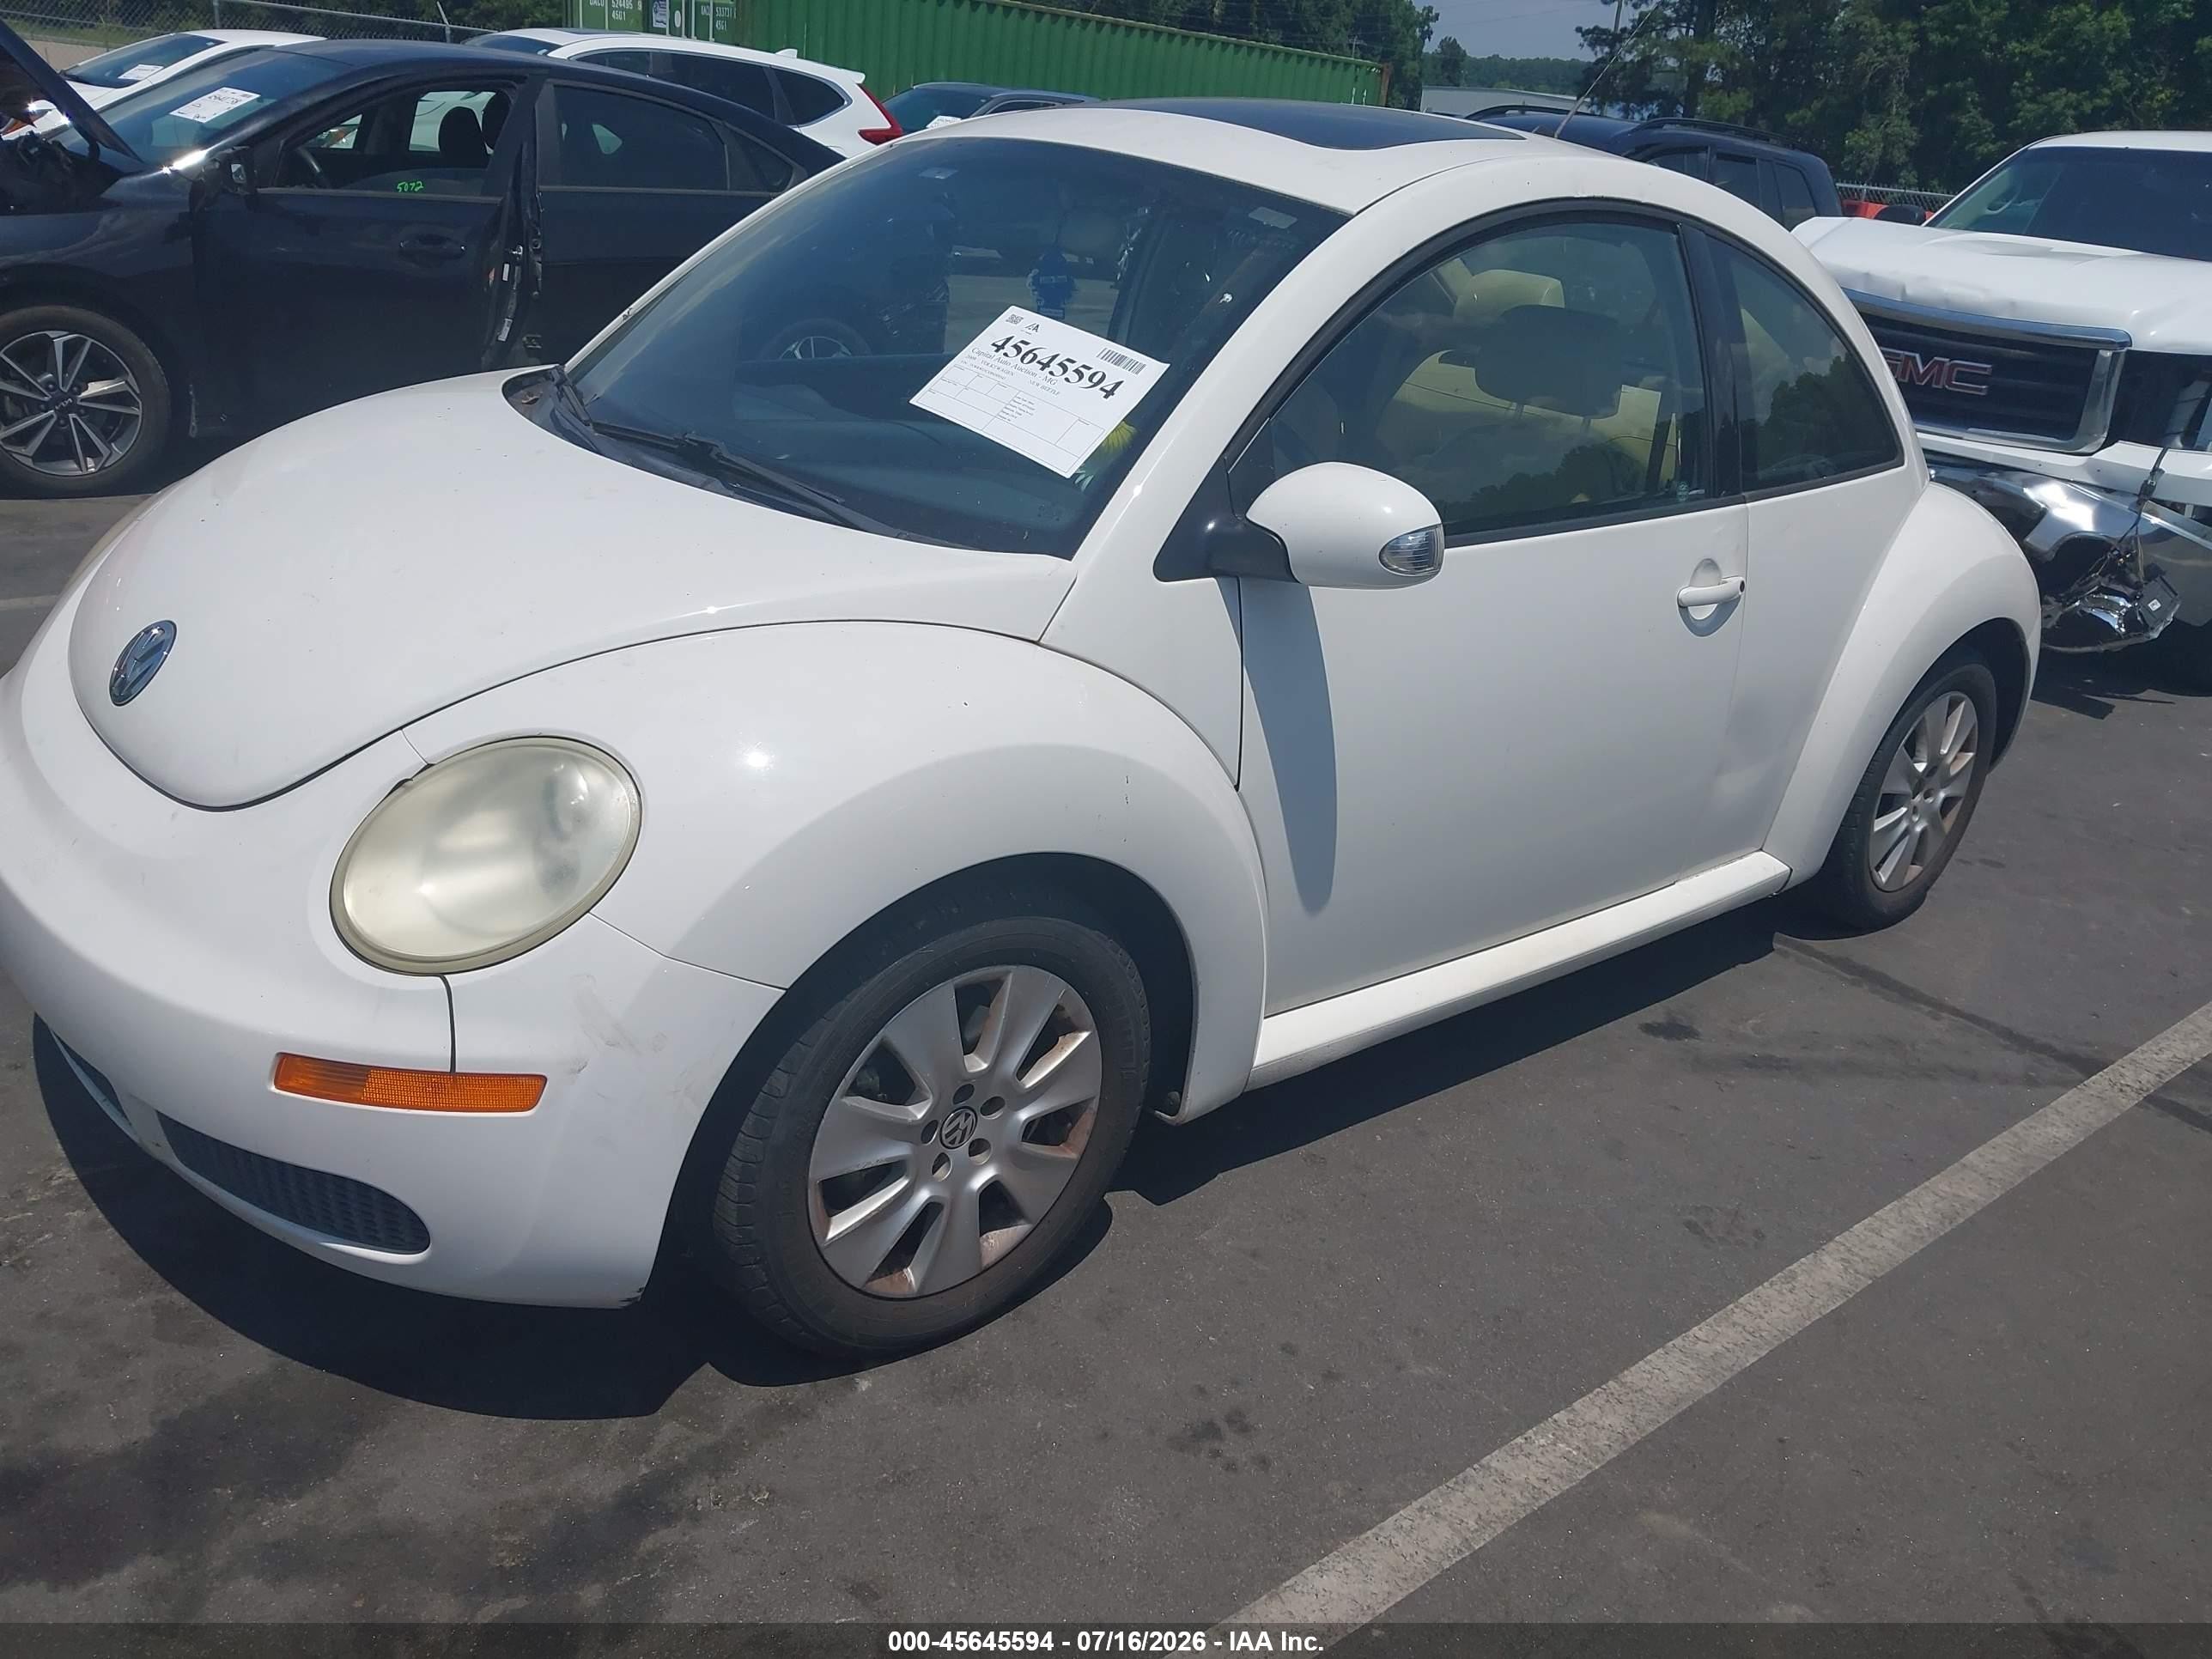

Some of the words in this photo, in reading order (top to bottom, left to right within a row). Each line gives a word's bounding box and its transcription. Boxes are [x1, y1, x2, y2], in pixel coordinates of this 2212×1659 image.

[397, 180, 424, 193] 5072
[971, 346, 996, 362] Capital
[993, 356, 1012, 367] Auto
[1009, 362, 1039, 378] Auction
[1040, 374, 1059, 386] MG
[991, 335, 1125, 399] 45645594
